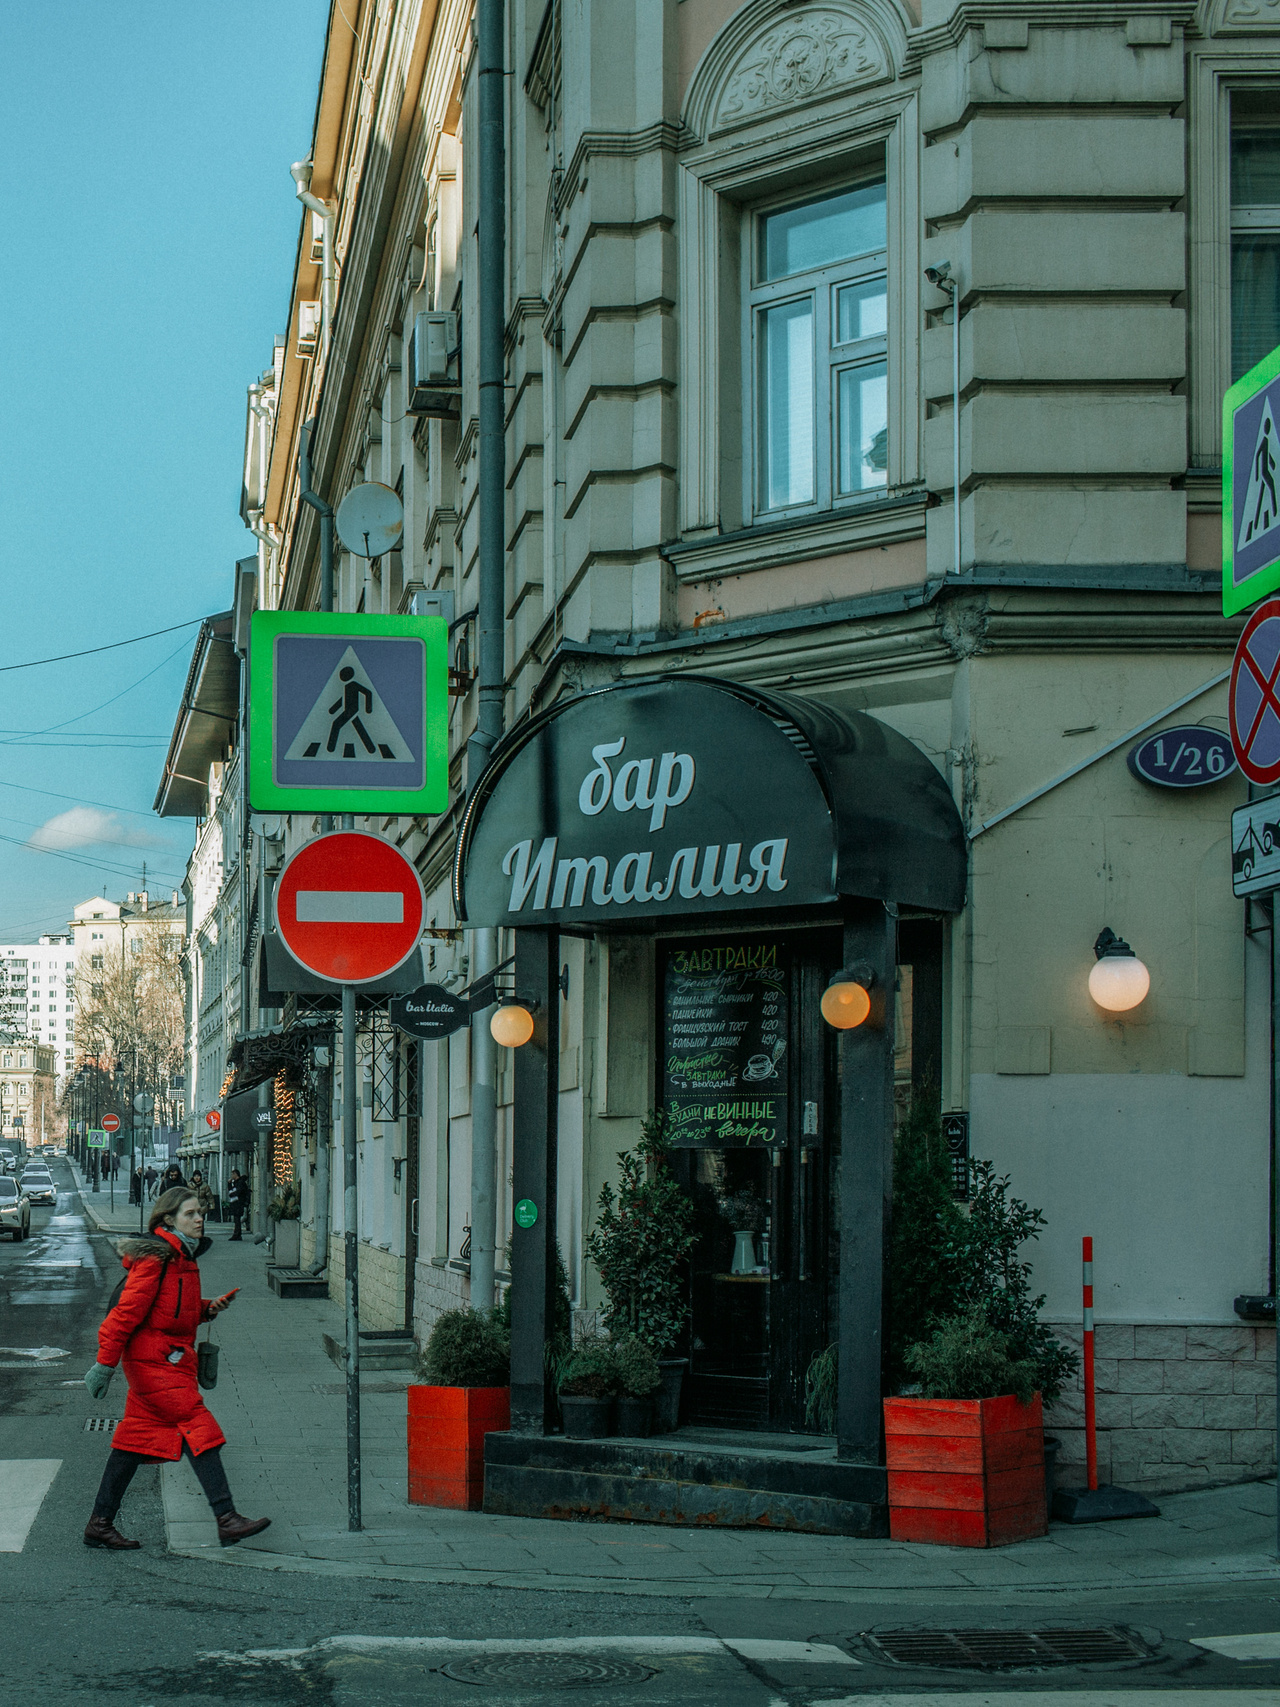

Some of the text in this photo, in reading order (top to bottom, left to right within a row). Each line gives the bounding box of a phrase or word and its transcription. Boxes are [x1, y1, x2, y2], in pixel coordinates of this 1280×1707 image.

[1153, 739, 1225, 775] 1/26
[578, 736, 696, 833] бар
[502, 836, 789, 912] Италия
[673, 945, 777, 973] ЗАВТРАКИ
[763, 991, 779, 1001] 420
[672, 1004, 778, 1020] ПАНКЕЙКИ 420
[672, 1020, 779, 1034] ФРАНЦУЗСКИЙ ТОСТ 420
[672, 1035, 708, 1049] БОЛЬШОЙ
[711, 1036, 741, 1047] ДРАНИК
[686, 1070, 726, 1081] ЗАВТРАКИ
[692, 1077, 738, 1089] ВЫХОДНЫЕ
[668, 1106, 701, 1124] БУДНИ
[670, 1101, 680, 1113] В
[715, 1120, 776, 1146] вечера
